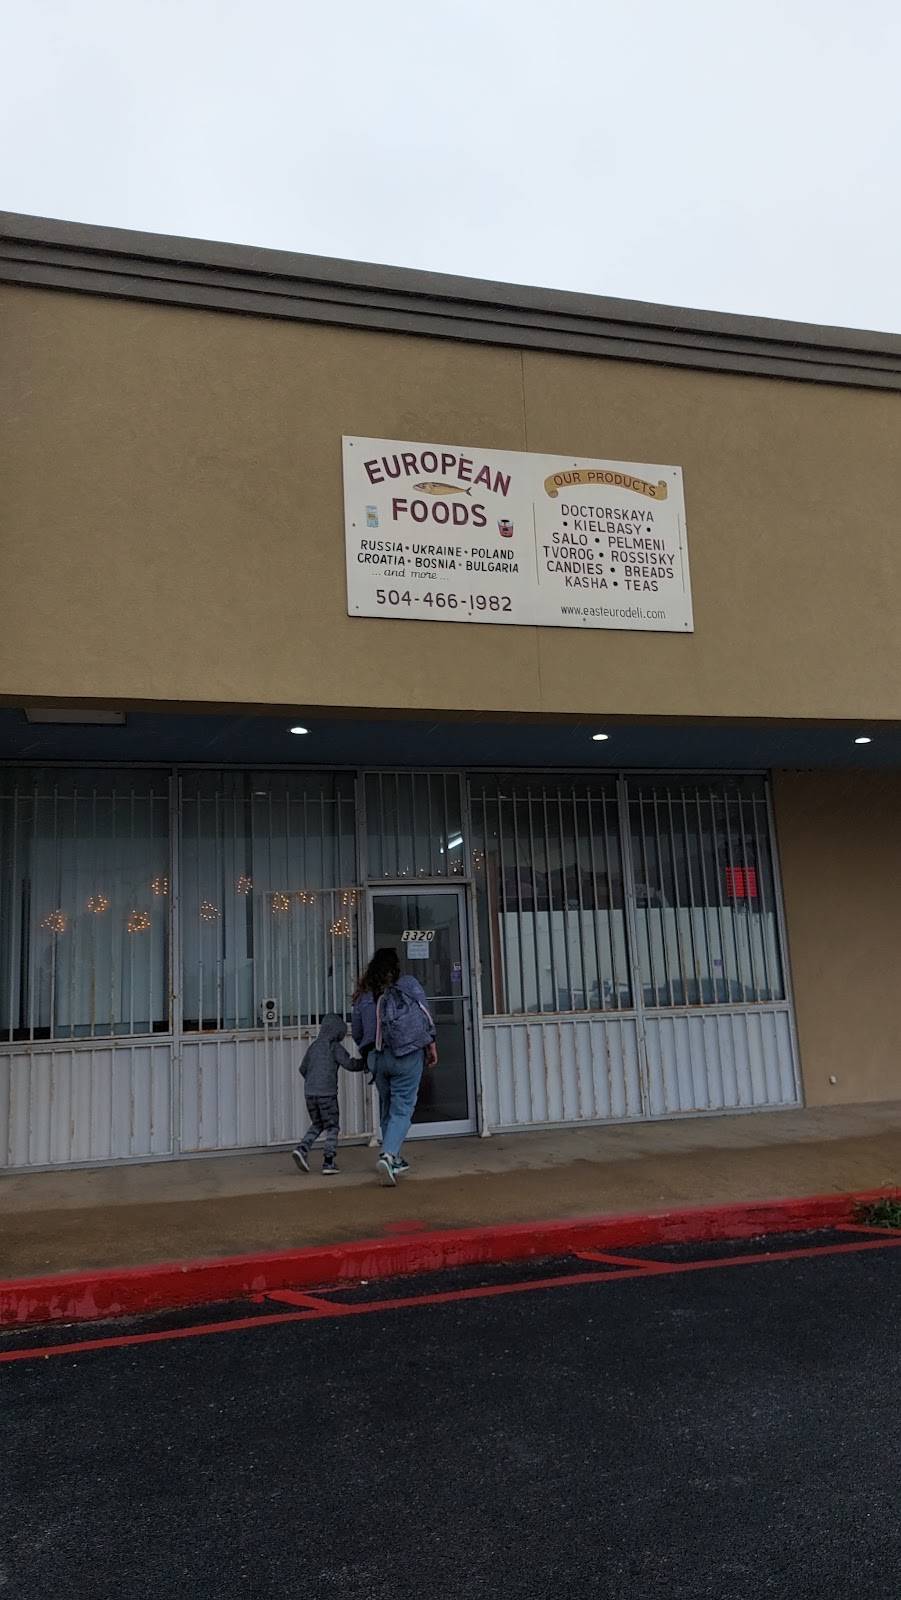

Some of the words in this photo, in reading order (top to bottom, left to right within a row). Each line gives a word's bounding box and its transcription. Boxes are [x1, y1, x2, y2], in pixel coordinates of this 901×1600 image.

[364, 451, 511, 496] EUROPEAN
[553, 472, 581, 486] OUR
[587, 472, 656, 497] PRODUCTS
[392, 497, 487, 527] FOODS
[561, 504, 654, 522] DOCTORSKAYA
[574, 520, 642, 534] KIELBASY
[360, 539, 403, 553] RUSSIA
[412, 544, 462, 557] UKRAINE
[471, 548, 514, 560] POLAND
[552, 532, 588, 546] SALO
[608, 536, 665, 551] PELMENI
[357, 552, 405, 566] CROATIA
[415, 557, 456, 570] BOSNIA
[466, 561, 519, 573] BULGARIA
[543, 545, 594, 560] TVOROG
[611, 551, 675, 565] ROSSISKY
[546, 561, 603, 575] CANDIES
[624, 566, 674, 579] BREADS
[565, 576, 608, 589] KASHA
[624, 580, 659, 592] TEAS
[376, 589, 512, 612] 504-466-1982
[561, 605, 666, 620] www.easteurodeli.com
[403, 931, 434, 941] 3320
